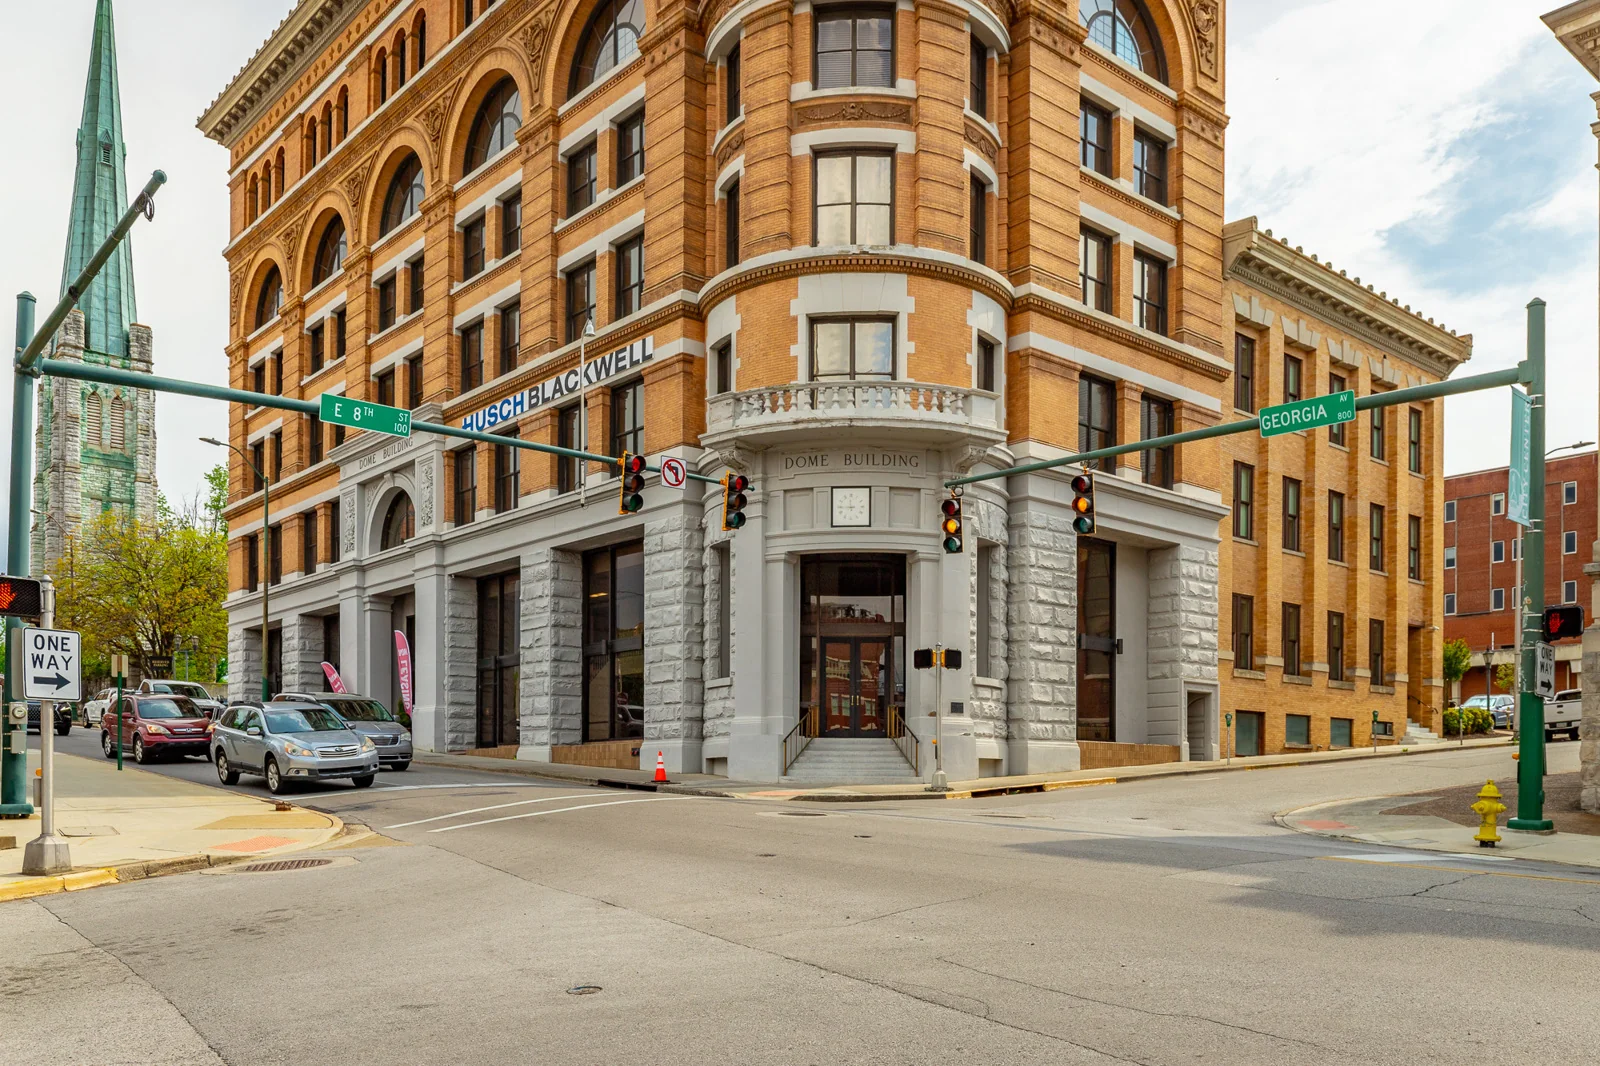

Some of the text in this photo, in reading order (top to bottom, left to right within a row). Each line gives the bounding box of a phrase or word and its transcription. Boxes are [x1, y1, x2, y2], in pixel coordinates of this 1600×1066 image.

[462, 336, 654, 432] HUSCH BLACKWELL
[1339, 393, 1348, 403] AV
[334, 402, 409, 422] E 8TH ST
[1261, 403, 1328, 430] GEORGIA
[1337, 410, 1352, 421] 800
[394, 422, 408, 434] 100
[359, 437, 414, 470] DOME BUILDING
[785, 453, 920, 470] DOME BUILDING
[33, 634, 71, 652] ONE
[31, 652, 73, 671] WAY
[1541, 646, 1553, 661] ONE
[1540, 660, 1553, 675] WAY
